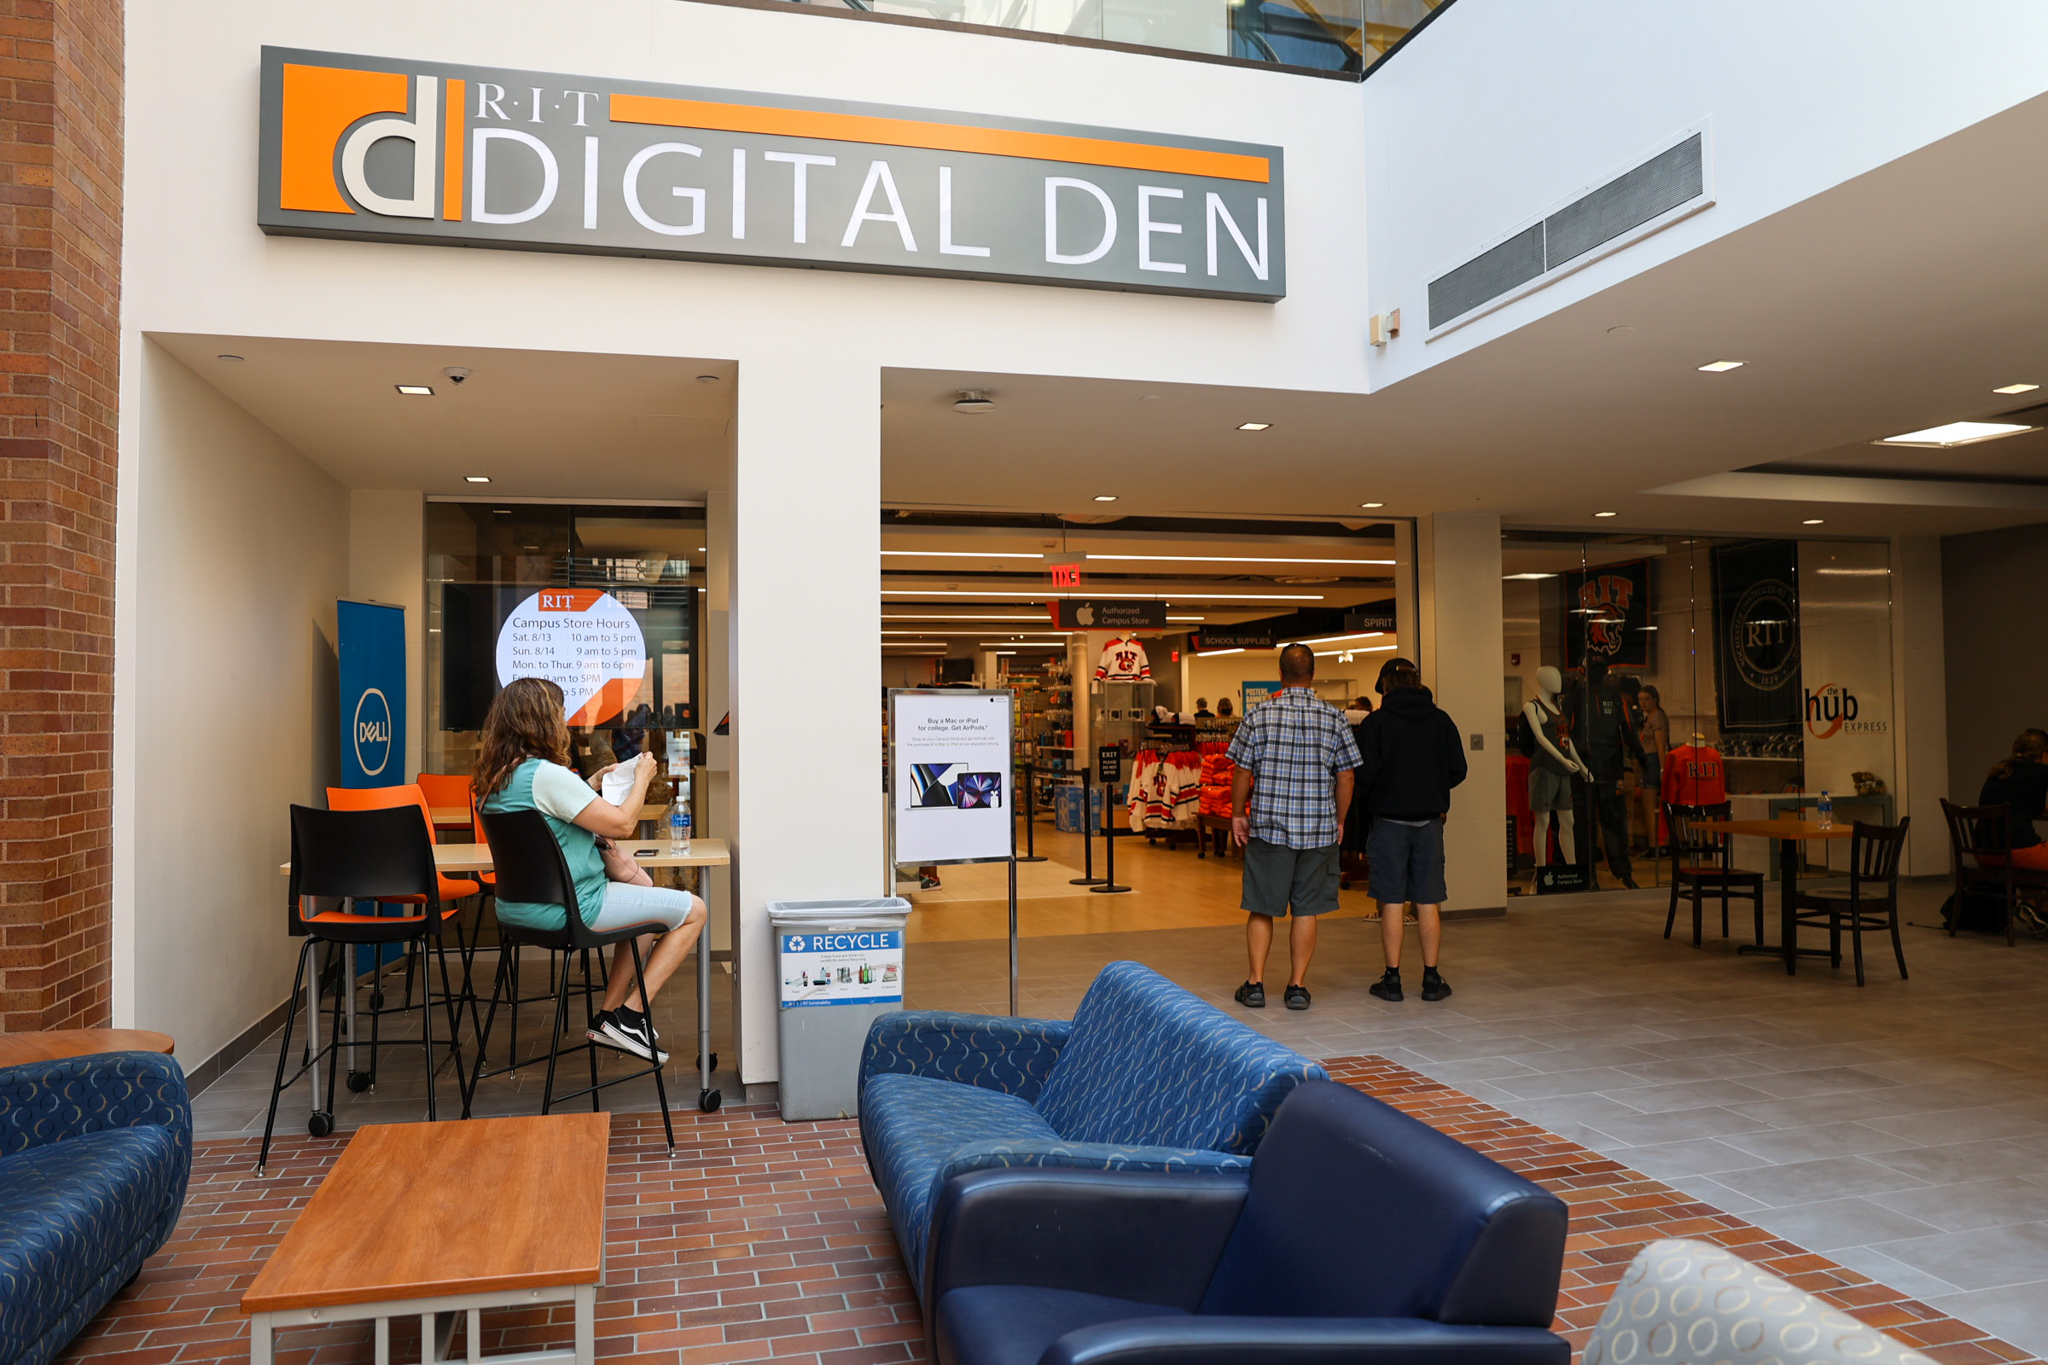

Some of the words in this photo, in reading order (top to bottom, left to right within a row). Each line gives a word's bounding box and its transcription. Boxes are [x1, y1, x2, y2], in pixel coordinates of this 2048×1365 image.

[471, 127, 990, 257] DIGITAL
[1045, 177, 1269, 281] DEN
[542, 594, 574, 608] RIT
[1578, 574, 1633, 618] RIT
[1102, 606, 1140, 614] Authorized
[512, 618, 560, 630] Campus
[563, 618, 593, 628] Store
[596, 618, 630, 628] Hours
[1102, 616, 1130, 625] Campus
[1132, 616, 1150, 624] Store
[1364, 618, 1393, 628] SPIRIT
[512, 633, 530, 642] Sat.
[532, 633, 552, 643] 8/13
[571, 634, 582, 642] 10
[613, 634, 618, 642] 5
[620, 636, 636, 644] pm
[1746, 621, 1788, 648] RIT
[1205, 637, 1235, 645] SCHOOL
[1237, 637, 1270, 645] SUPPLIES
[512, 647, 532, 656] Sun.
[535, 647, 554, 656] 8/14
[576, 648, 582, 656] 9
[614, 648, 618, 656] 5
[621, 649, 636, 658] pm
[1115, 651, 1137, 660] RIT
[512, 661, 536, 669] Mon.
[551, 660, 574, 669] Thur.
[576, 661, 582, 669] 9
[613, 661, 634, 670] 6pm
[581, 674, 600, 682] 5PM
[571, 688, 576, 696] 5
[579, 688, 594, 696] PM
[1827, 687, 1838, 695] the
[1804, 688, 1858, 721] hub
[360, 721, 388, 743] DELL
[1844, 722, 1887, 732] EXPRESS
[1687, 762, 1718, 777] RIT
[813, 934, 889, 950] RECYCLE
